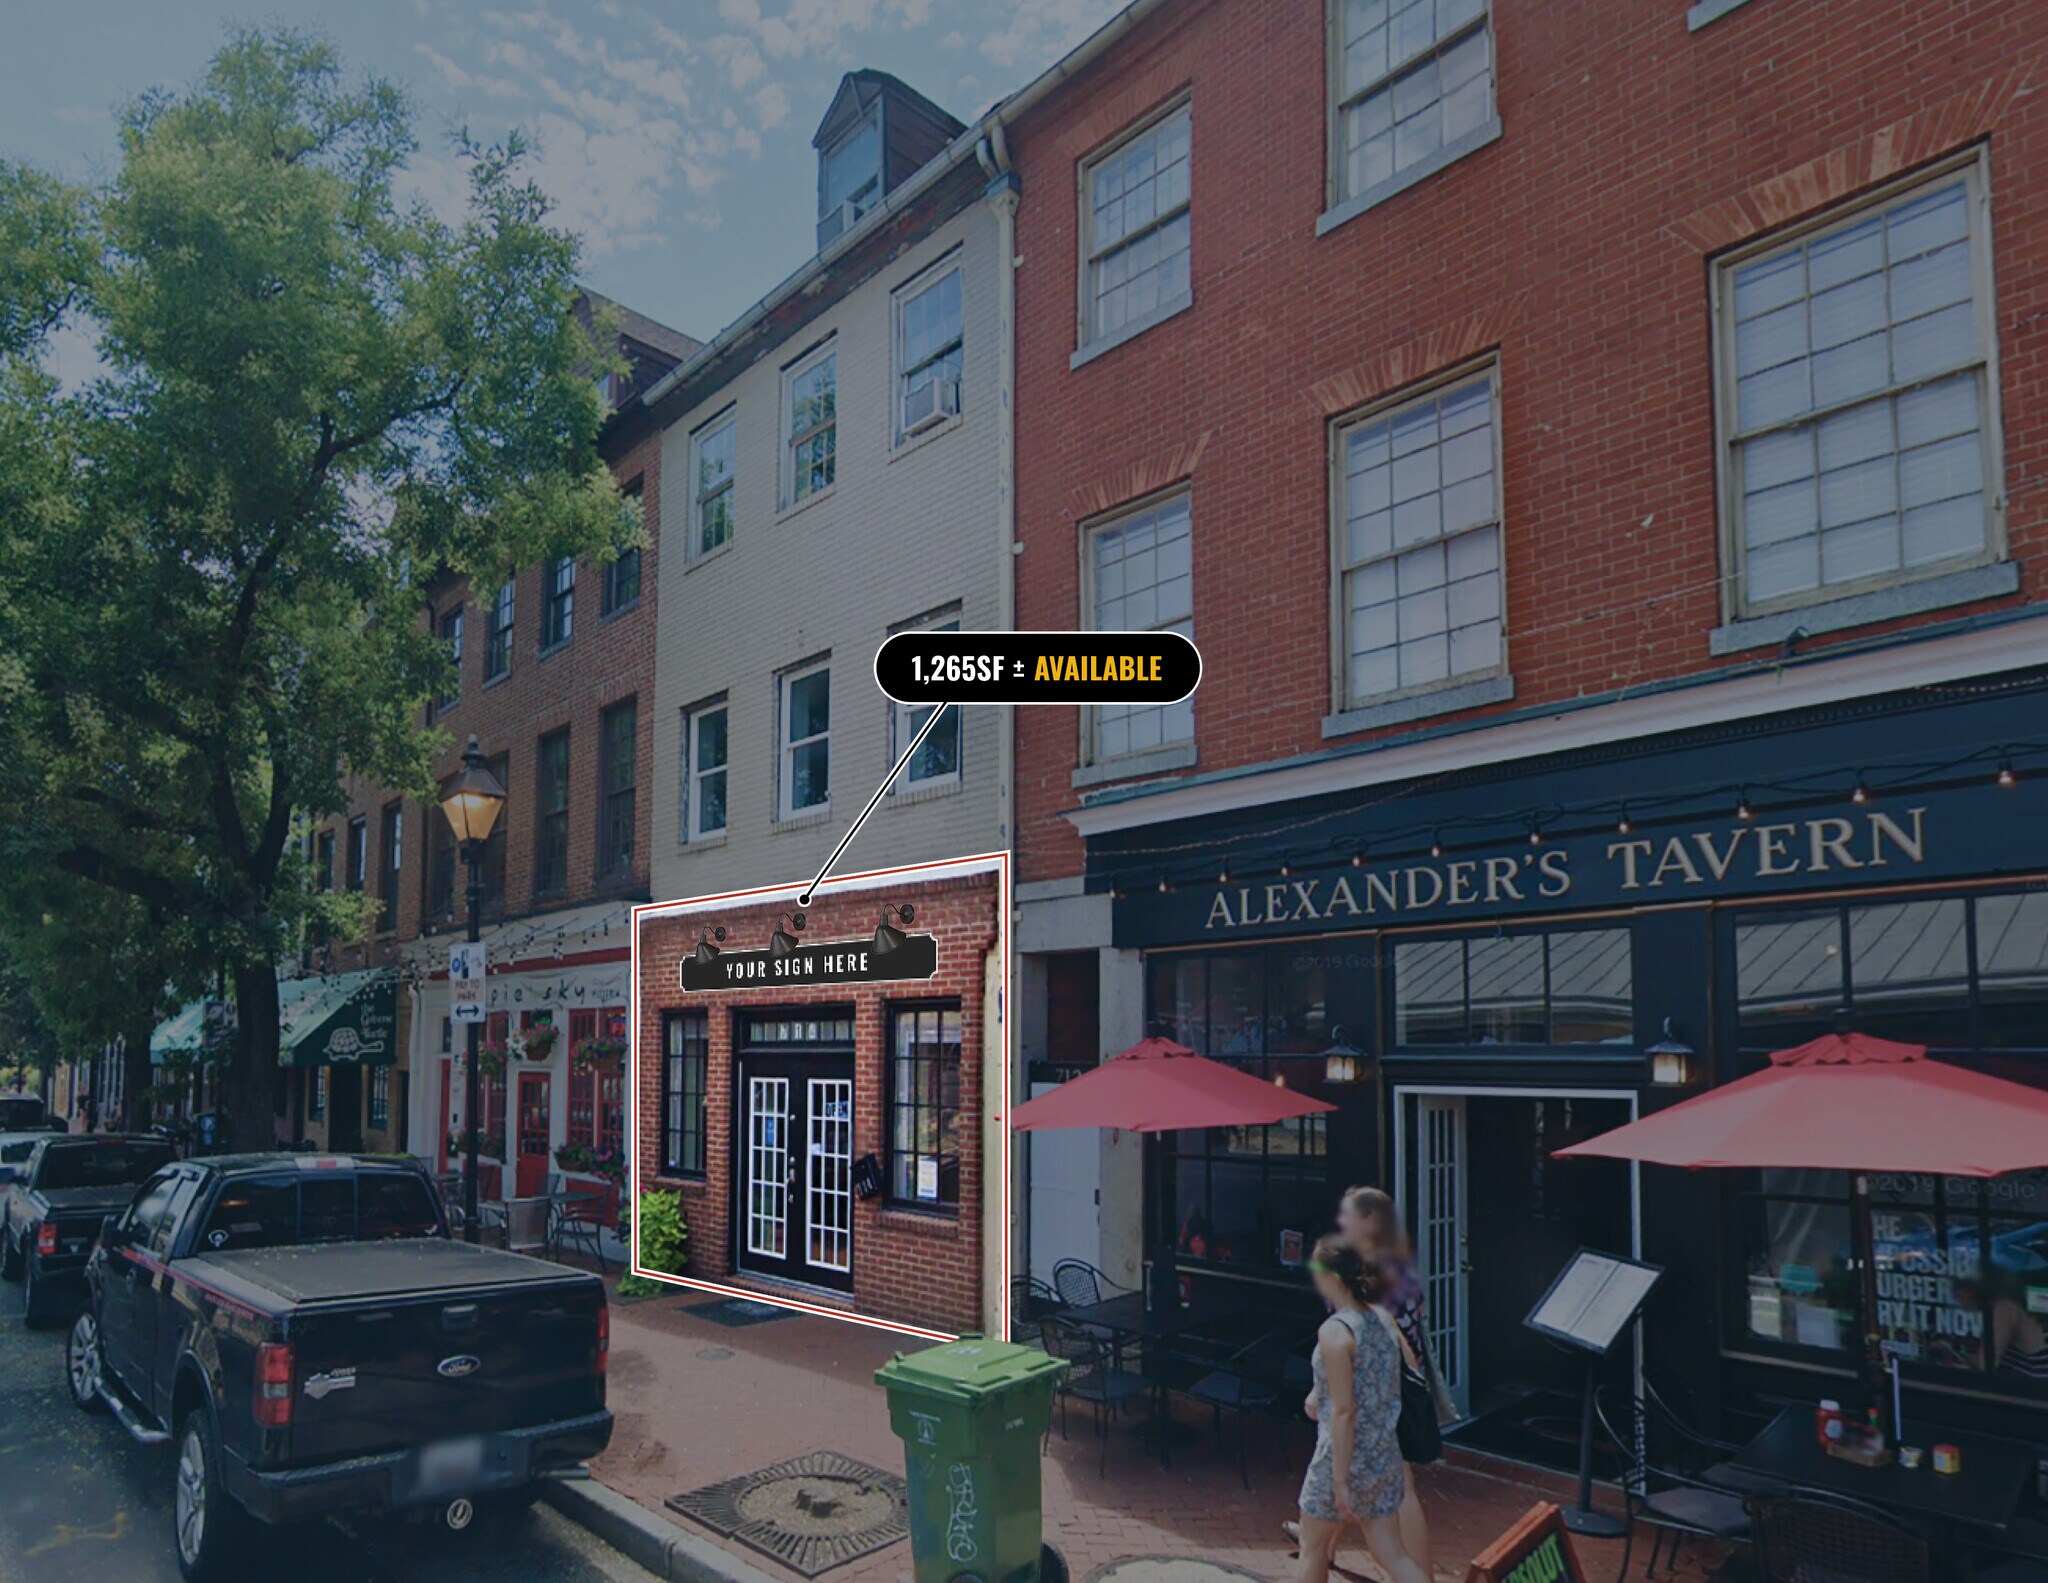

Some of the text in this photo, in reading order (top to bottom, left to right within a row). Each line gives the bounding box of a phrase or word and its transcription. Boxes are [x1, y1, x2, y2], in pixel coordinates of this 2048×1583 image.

[1204, 807, 1928, 929] ALEXANDER'S TAVERN
[726, 952, 868, 979] YOUR SIGN HERE
[490, 983, 523, 1008] pie
[542, 979, 585, 1005] sky
[1872, 1213, 1901, 1239] HE
[1876, 1271, 1955, 1302] URGER
[1877, 1300, 1907, 1327] RY
